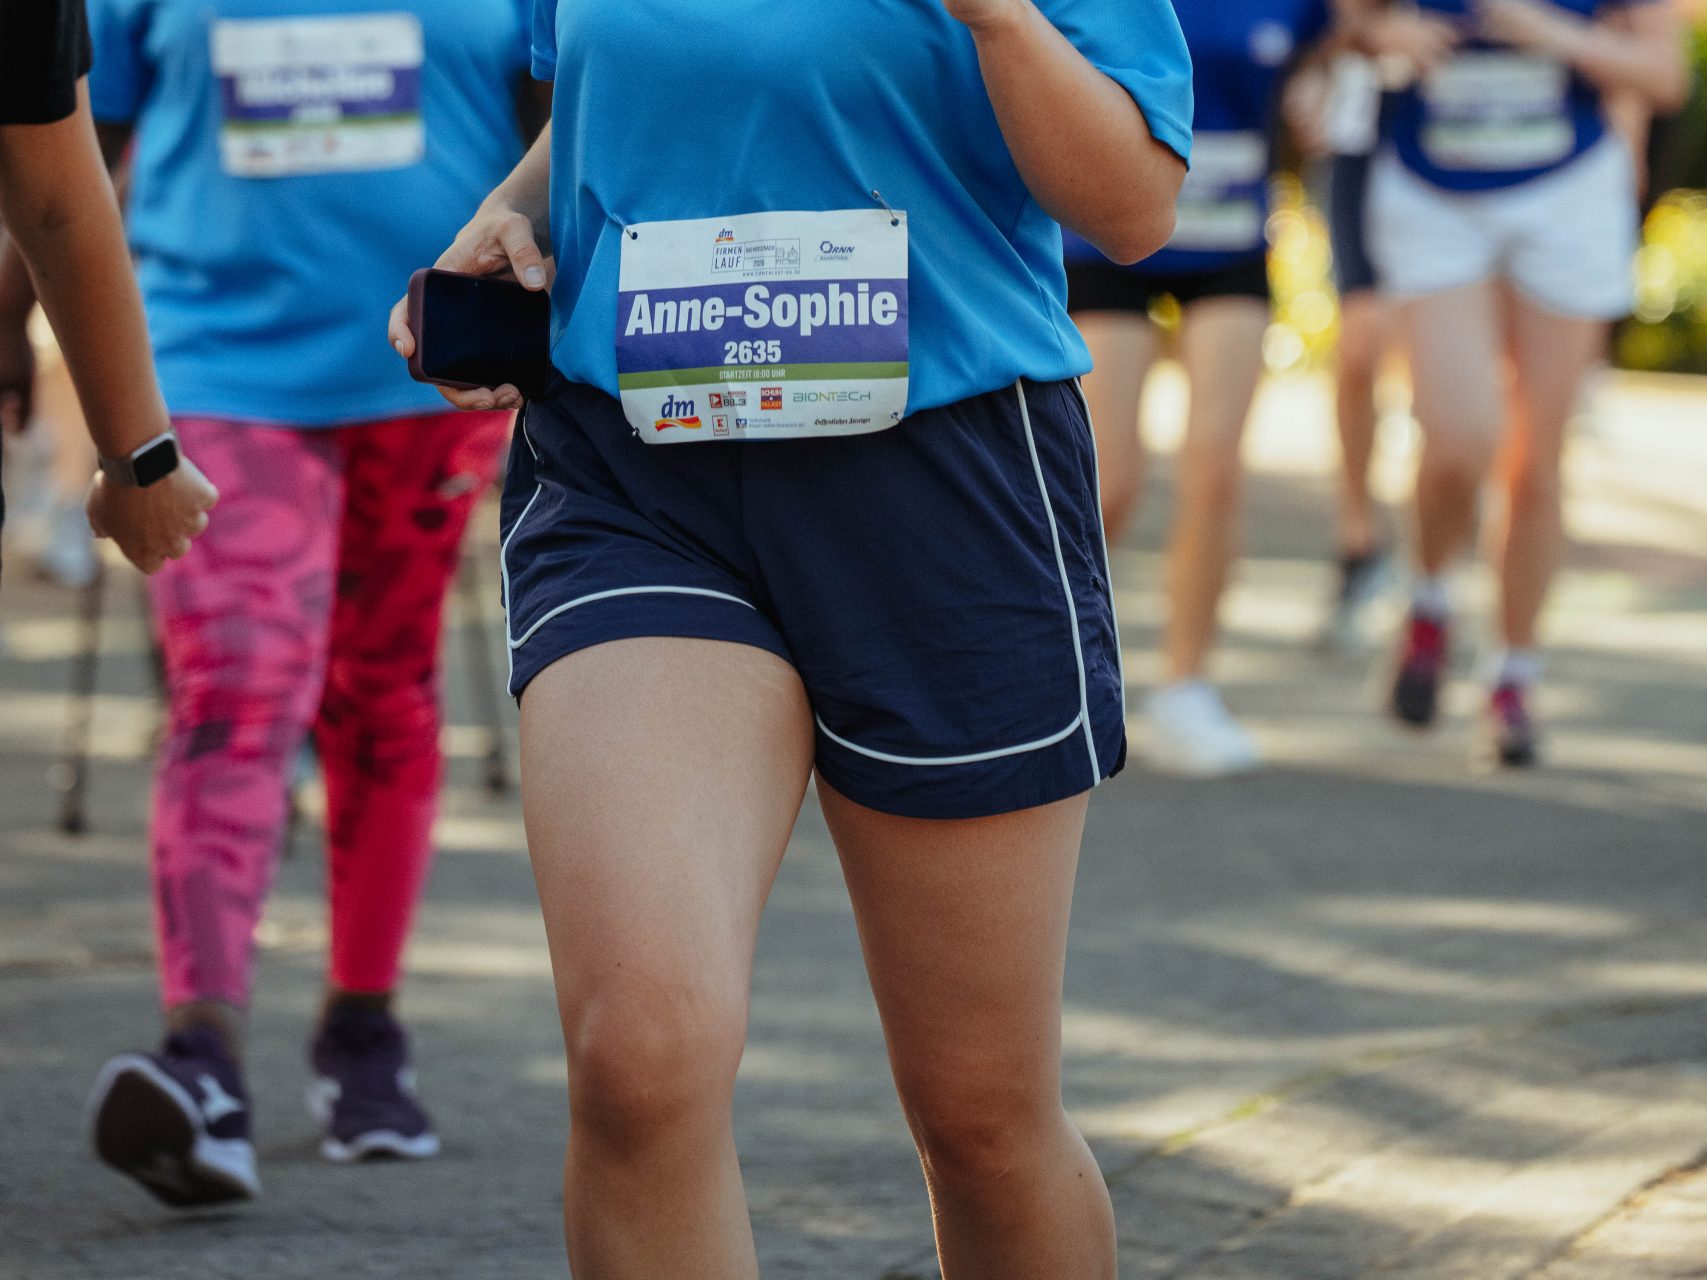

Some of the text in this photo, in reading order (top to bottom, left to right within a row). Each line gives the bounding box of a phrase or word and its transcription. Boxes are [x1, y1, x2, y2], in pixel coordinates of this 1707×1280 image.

[718, 228, 733, 238] dm
[715, 246, 743, 256] FIRMEN
[714, 256, 742, 269] LAUF
[625, 283, 898, 336] Anne-Sophie
[723, 340, 782, 364] 2635
[719, 369, 752, 380] STARTZEIT
[771, 368, 786, 378] UHR
[761, 389, 782, 397] SCHUH
[793, 392, 871, 402] BIONTECH
[661, 394, 694, 418] dm
